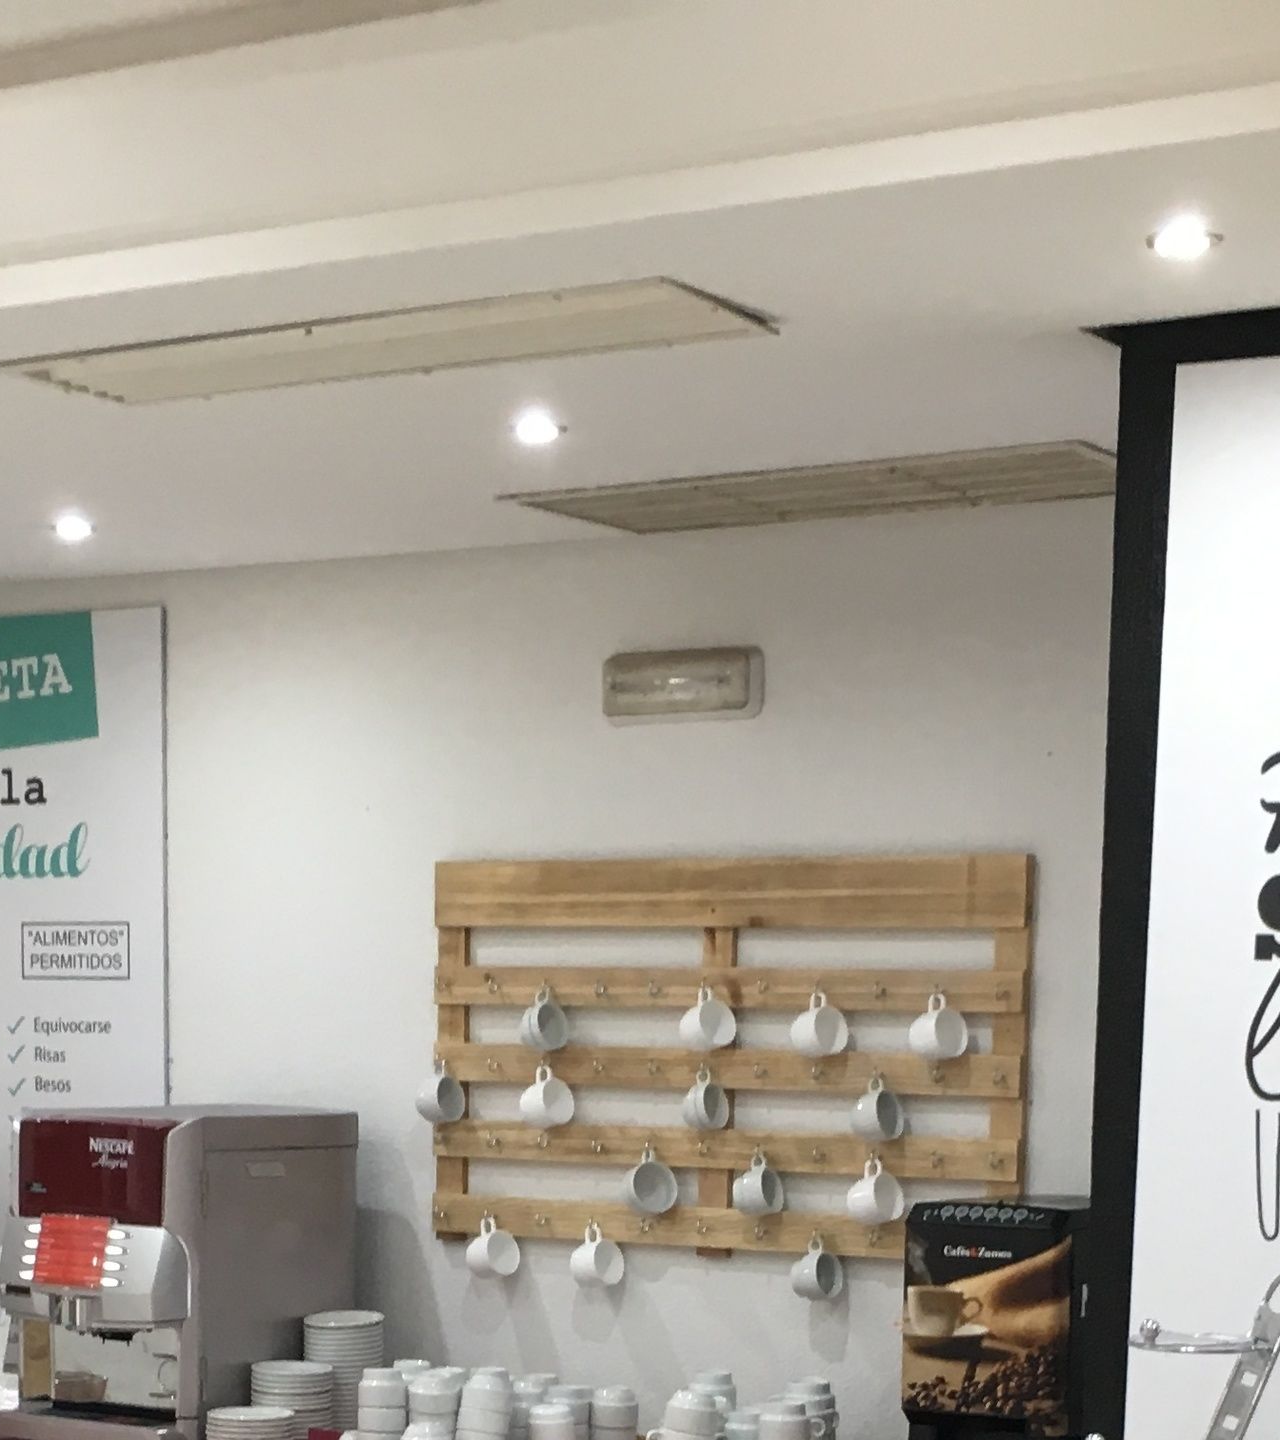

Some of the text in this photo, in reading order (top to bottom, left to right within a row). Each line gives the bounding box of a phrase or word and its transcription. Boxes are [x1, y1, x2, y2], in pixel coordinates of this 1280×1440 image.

[0, 768, 48, 806] la
[28, 930, 124, 947] "ALIMENTOS"
[30, 953, 122, 970] PERMITIDOS
[33, 1016, 111, 1036] Equivocarse
[34, 1046, 66, 1063] Risas
[34, 1075, 71, 1093] Besos
